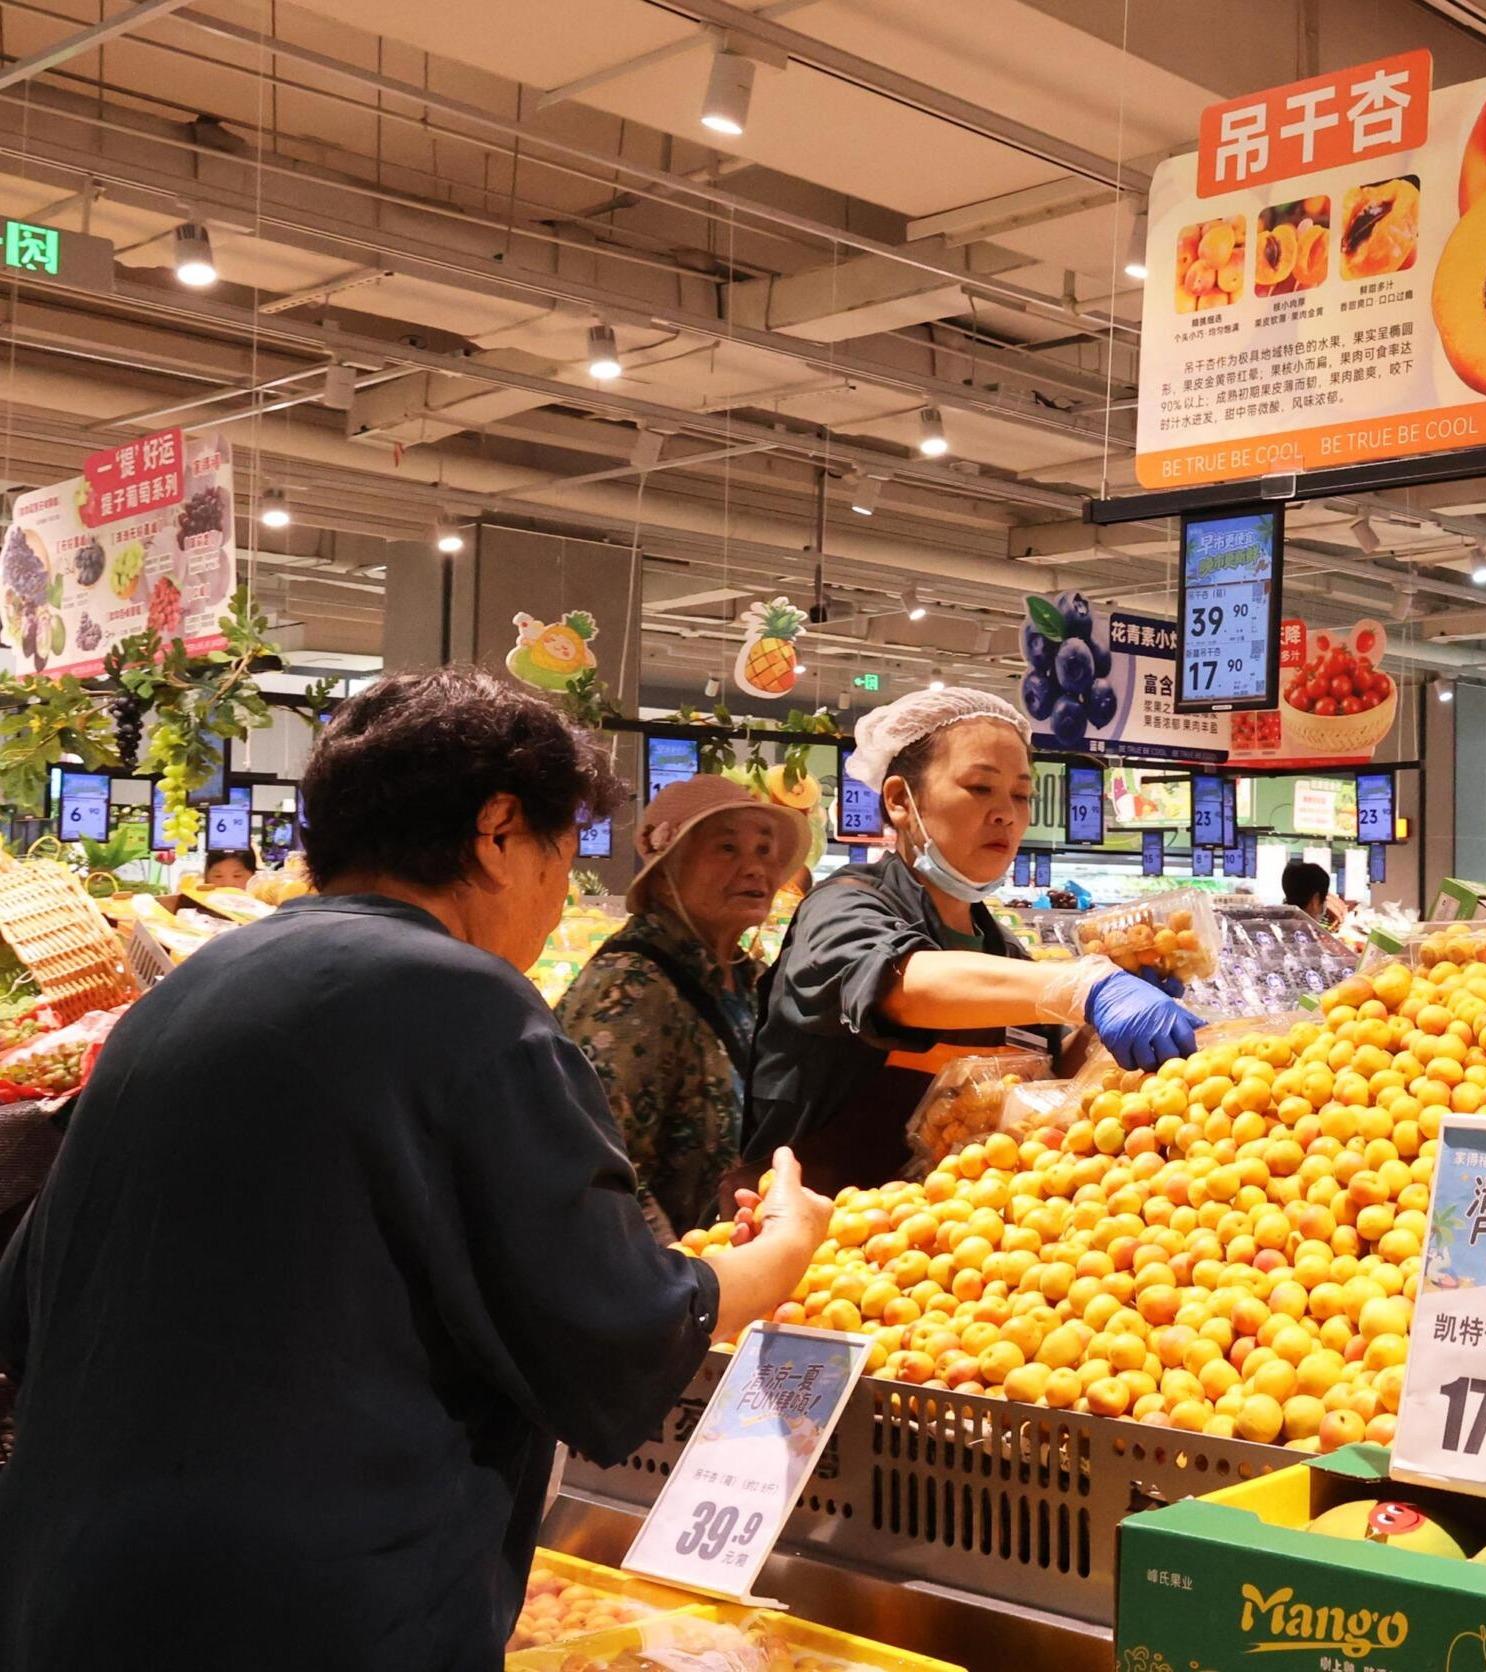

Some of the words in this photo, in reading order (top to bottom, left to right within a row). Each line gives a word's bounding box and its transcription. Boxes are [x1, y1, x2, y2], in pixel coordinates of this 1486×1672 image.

[1214, 69, 1412, 183] 吊干杏
[1320, 435, 1342, 455] BE
[1347, 428, 1393, 451] TRUE
[1397, 422, 1420, 444] BE
[1425, 415, 1479, 441] COOL
[1161, 459, 1181, 478] BE
[1186, 454, 1225, 474] TRUE
[1231, 451, 1250, 469] BE
[1255, 441, 1304, 465] COOL
[1233, 604, 1249, 617] 90
[1227, 658, 1243, 672] 90
[1144, 673, 1174, 697] 富含
[70, 808, 82, 823] 6
[845, 814, 862, 828] 23
[1071, 805, 1088, 822] 19
[1196, 811, 1211, 826] 23
[1360, 808, 1378, 824] 23
[216, 819, 227, 833] 6
[741, 1364, 825, 1391] 清凉一夏
[675, 1500, 764, 1561] 39.9
[1147, 1569, 1193, 1591] 峰氏果业
[1241, 1583, 1409, 1658] Mango
